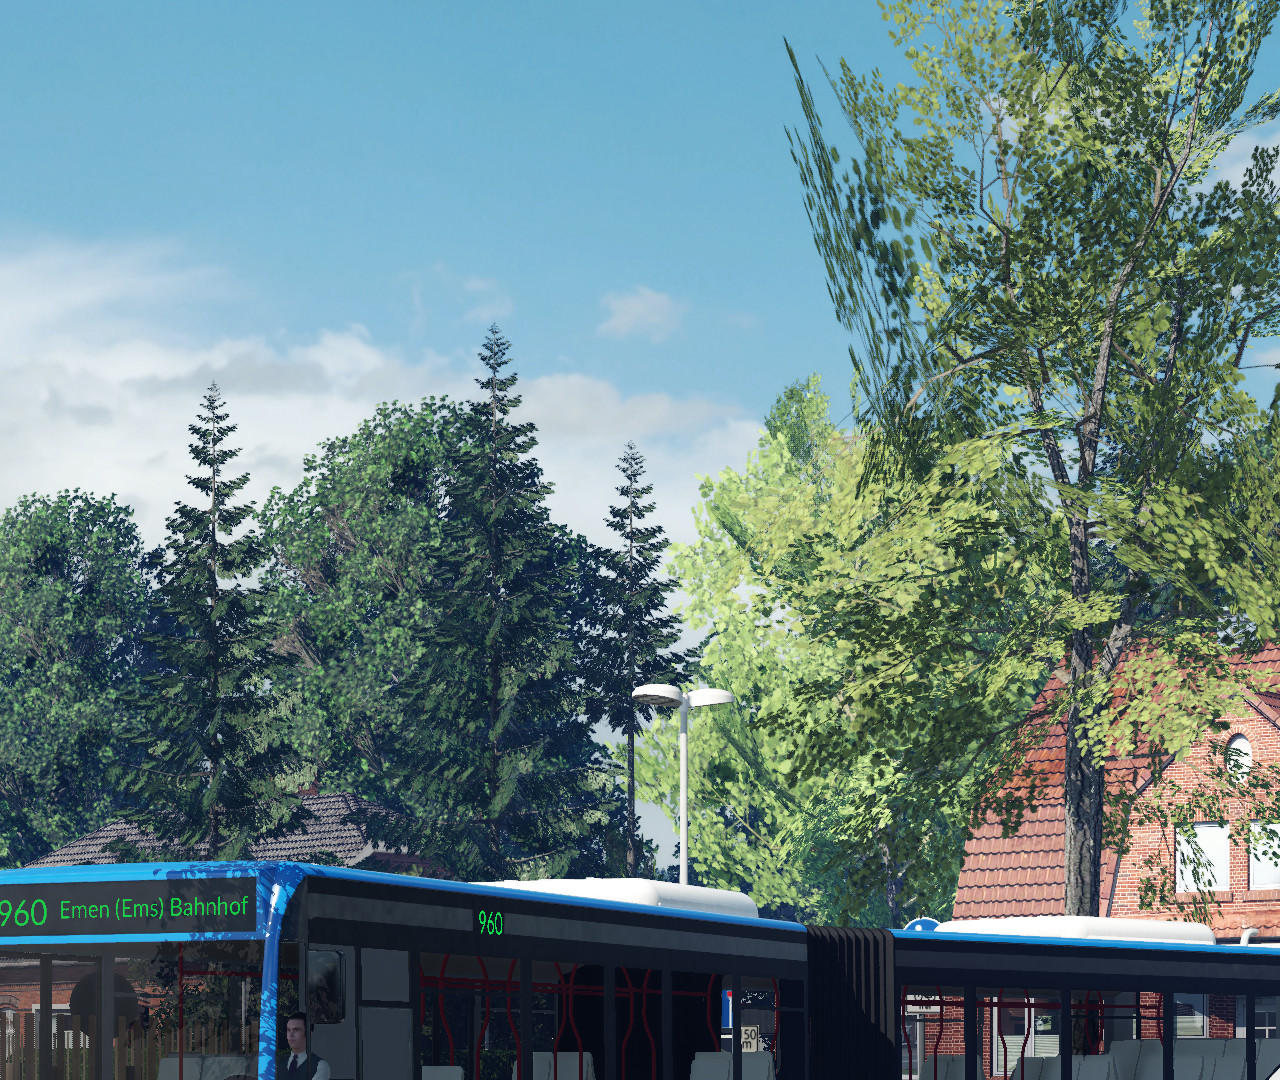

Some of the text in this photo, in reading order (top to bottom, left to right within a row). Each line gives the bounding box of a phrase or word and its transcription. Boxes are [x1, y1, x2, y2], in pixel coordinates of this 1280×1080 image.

[60, 900, 110, 919] Emen
[115, 897, 164, 920] (Ems)
[170, 895, 249, 917] Bahnhof
[478, 910, 503, 935] 960
